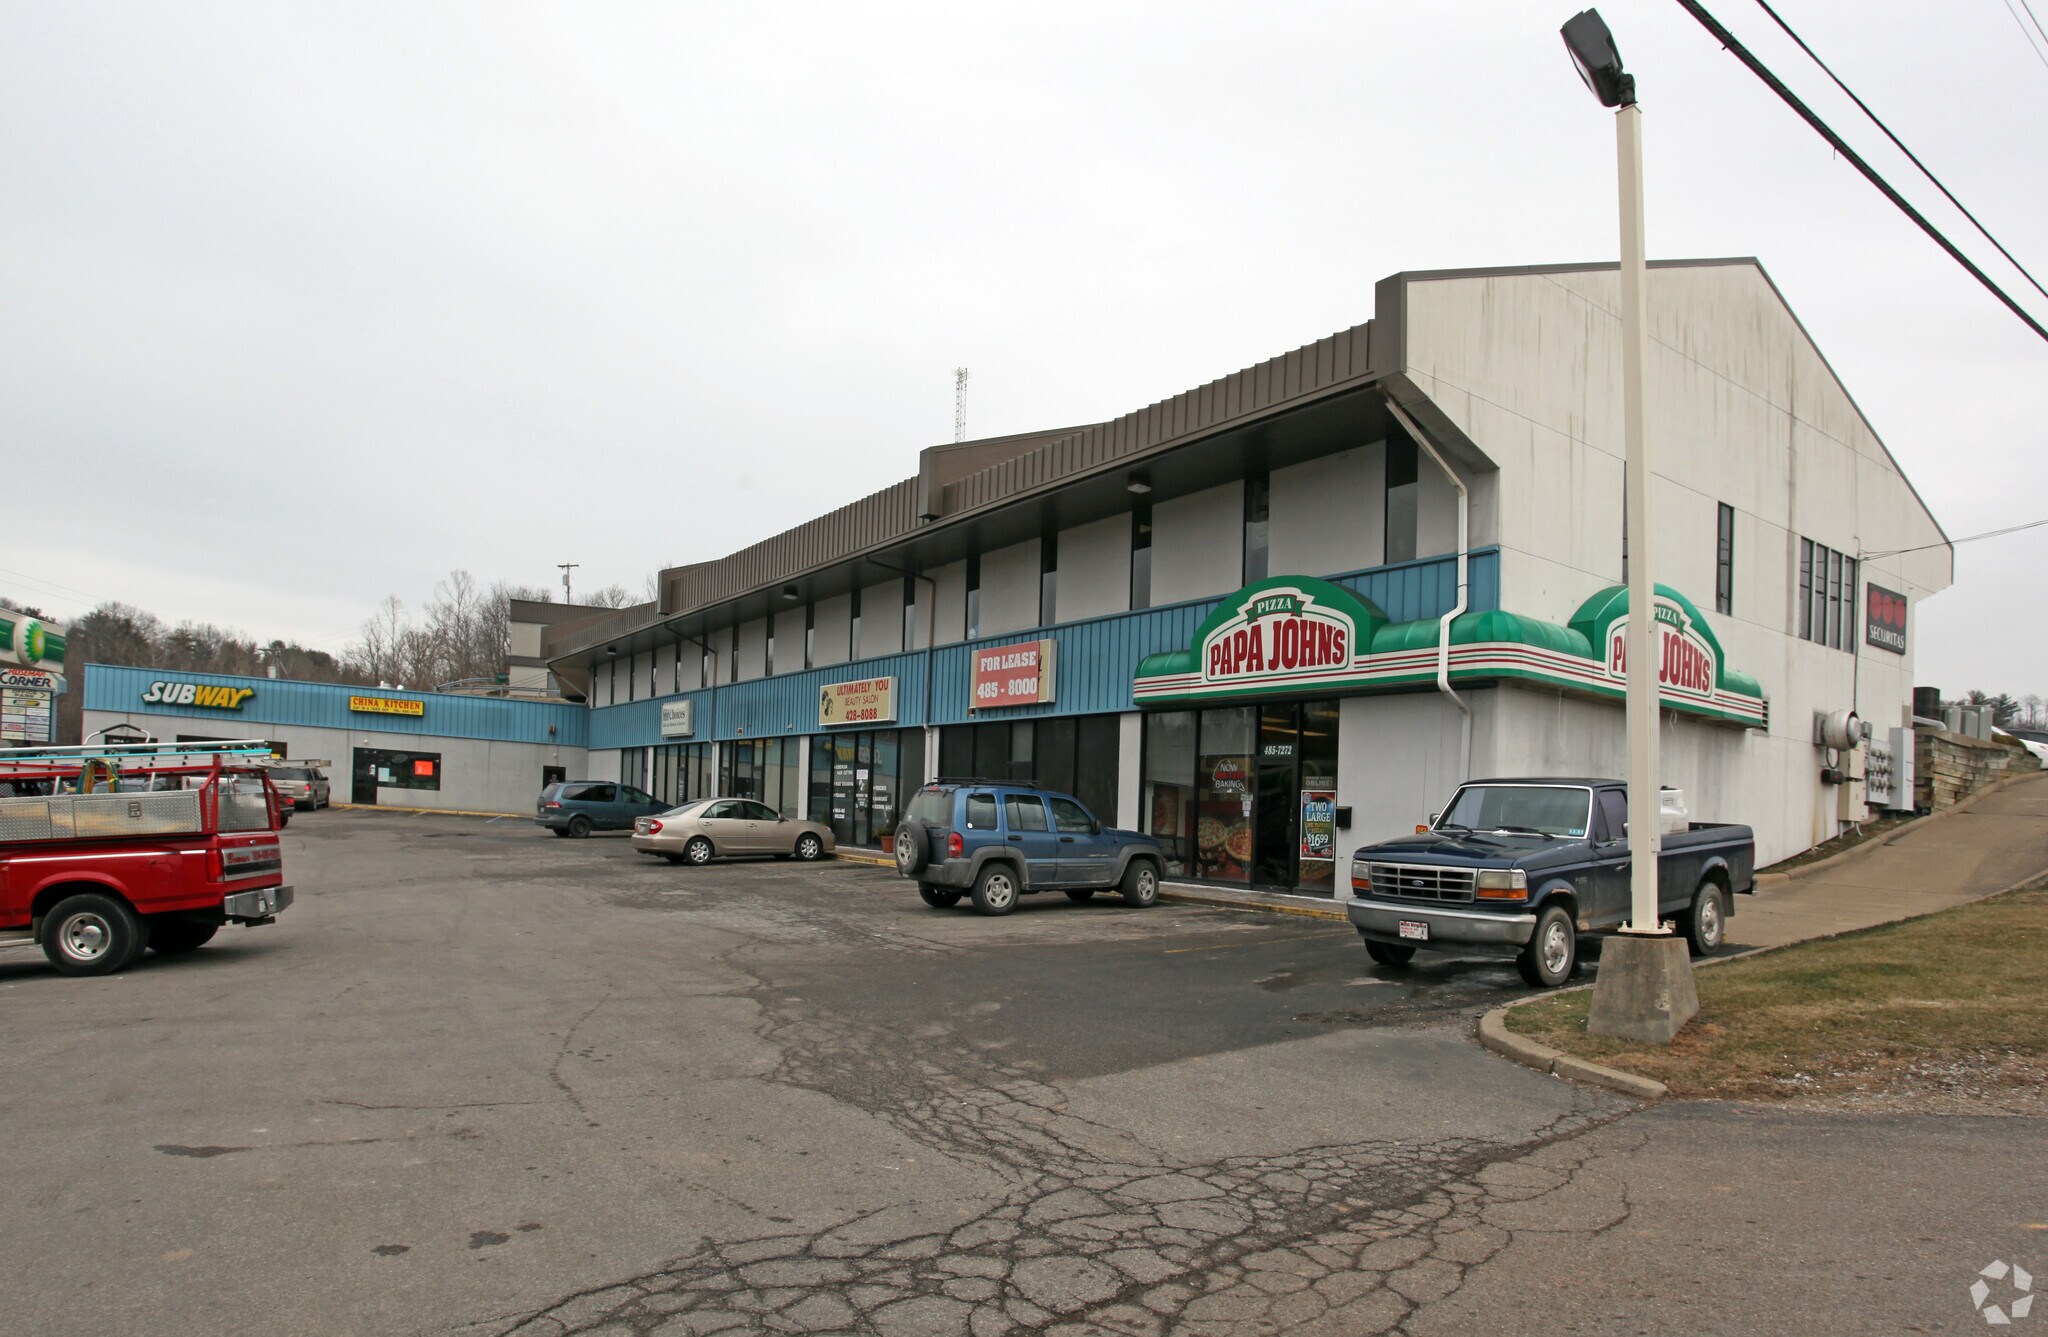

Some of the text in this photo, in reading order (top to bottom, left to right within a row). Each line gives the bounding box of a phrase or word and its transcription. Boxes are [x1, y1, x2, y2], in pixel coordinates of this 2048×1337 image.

[1257, 598, 1292, 614] PIZZA
[1869, 625, 1904, 649] SECURITAS
[1210, 618, 1346, 676] PAPA JOHN'S
[981, 651, 1037, 672] FOR LEASE
[0, 672, 51, 687] CORNER
[837, 679, 889, 696] ULTIMATELY YOU
[142, 681, 254, 708] SUBWAY
[845, 695, 879, 706] BEAUTY SALON
[353, 698, 421, 710] CHINA KITCHEN
[846, 708, 877, 721] 428-8088
[1264, 745, 1292, 755] 485-7272
[1220, 763, 1238, 772] NOW
[1215, 780, 1240, 788] BAKING
[1311, 802, 1327, 812] TWO
[1307, 812, 1330, 822] LARGE
